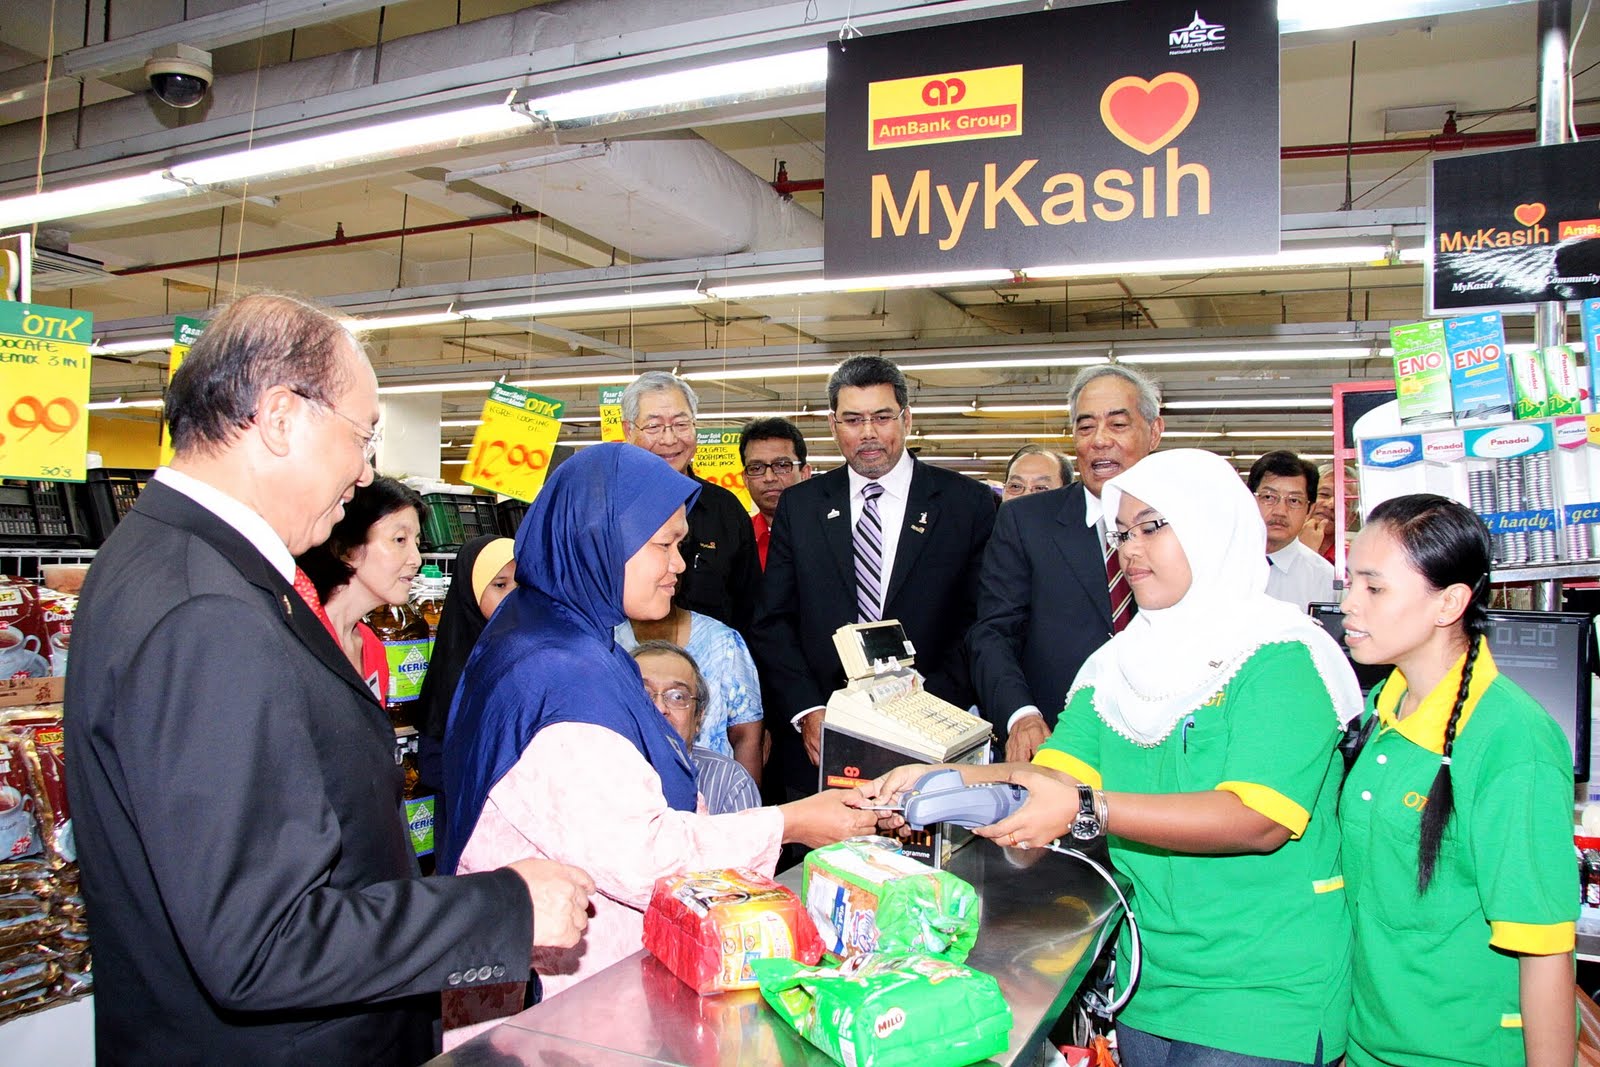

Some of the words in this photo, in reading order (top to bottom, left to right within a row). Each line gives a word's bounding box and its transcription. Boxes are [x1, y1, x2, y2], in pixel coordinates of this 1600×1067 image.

[1169, 27, 1226, 46] MSC
[1181, 41, 1213, 49] MALAYSIA
[879, 117, 951, 138] AmBank
[956, 113, 1012, 130] Group
[870, 147, 1211, 251] MyKasih
[1440, 223, 1549, 254] MyKasih
[1452, 281, 1494, 293] MyKasih
[22, 314, 85, 340] OTK
[48, 356, 59, 366] 3
[63, 357, 77, 368] IN
[82, 357, 86, 369] 1
[1398, 352, 1442, 376] ENO
[1454, 344, 1500, 370] ENO
[1530, 358, 1539, 390] Panadol
[1561, 353, 1570, 386] Panadol
[525, 398, 561, 417] OTK
[1557, 427, 1586, 435] Panadol
[1427, 442, 1463, 451] Panadol
[1490, 436, 1530, 446] Panadol
[696, 453, 736, 461] TOOTHPASTE
[1376, 446, 1412, 456] Panadol
[1499, 513, 1553, 529] handy.
[1572, 507, 1599, 523] get
[1496, 627, 1555, 647] 0.20
[398, 660, 429, 674] KERIS
[877, 1012, 903, 1033] MILO
